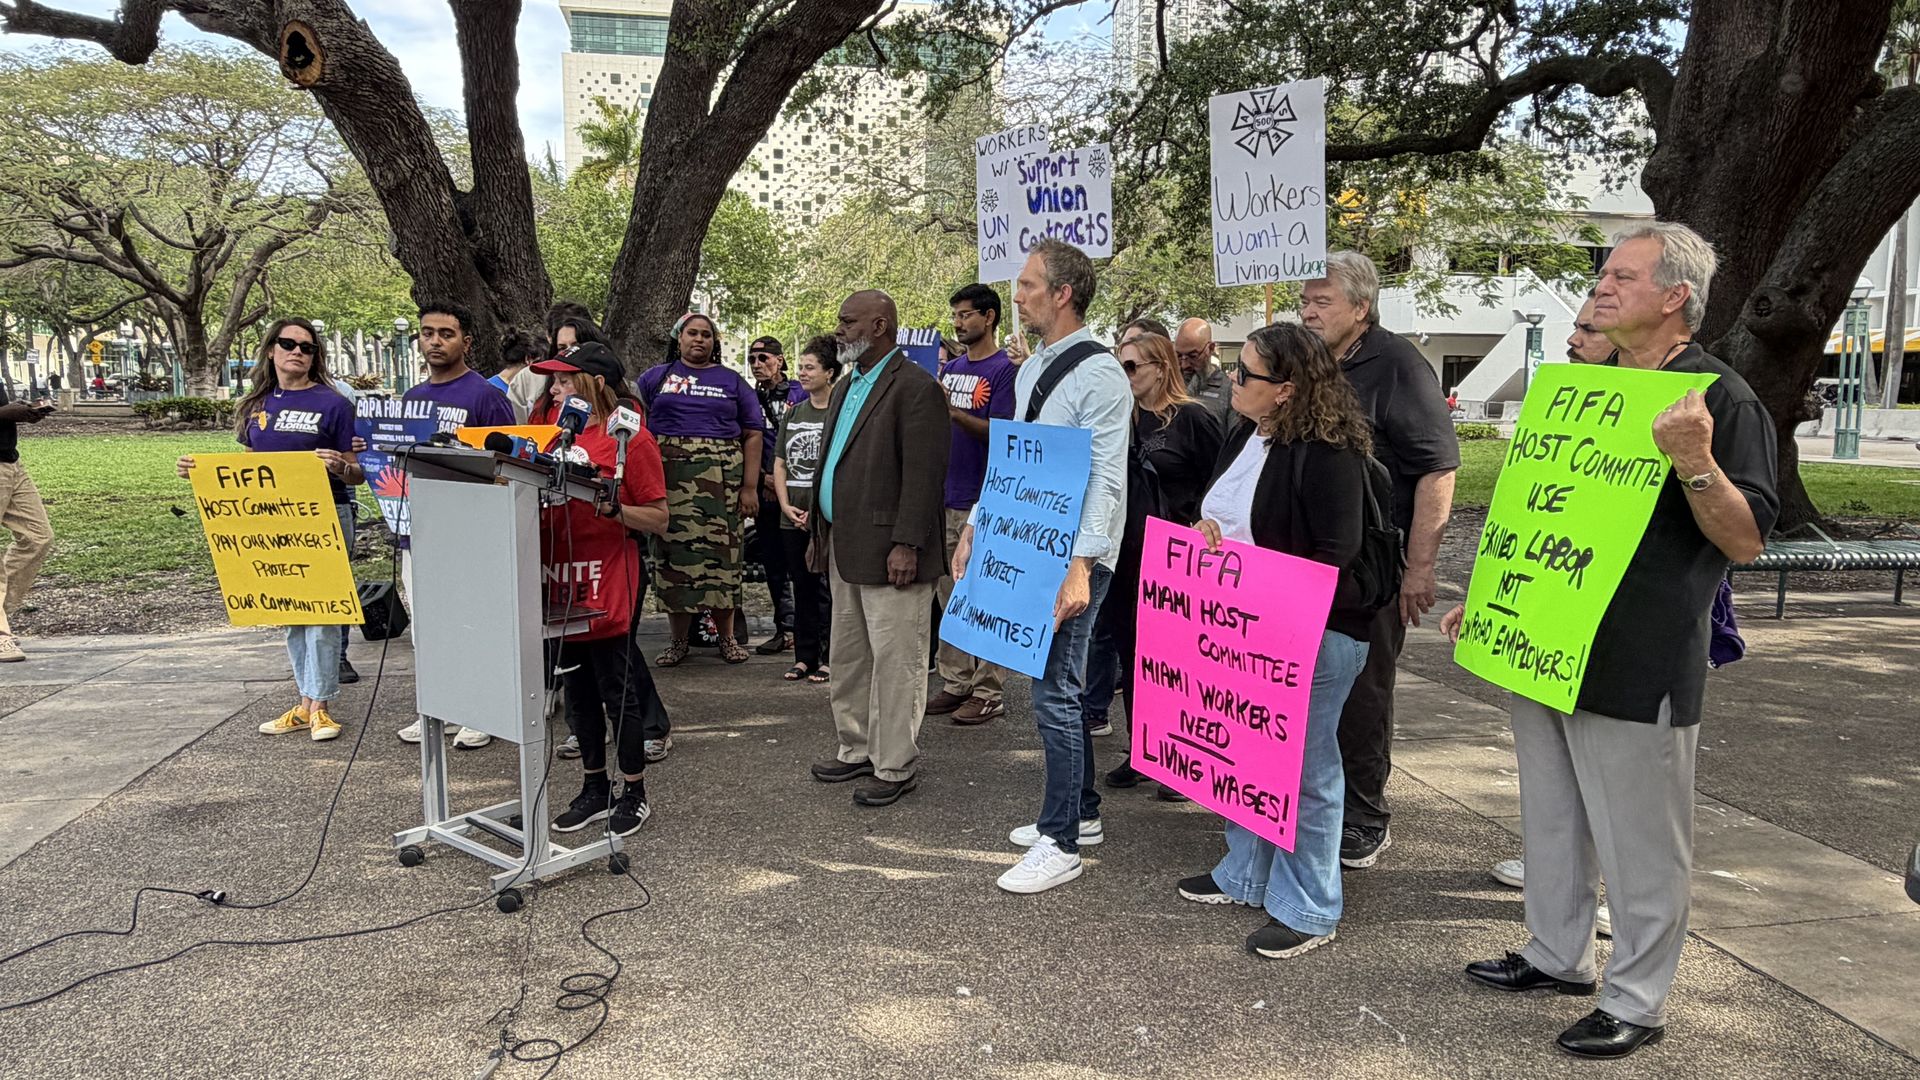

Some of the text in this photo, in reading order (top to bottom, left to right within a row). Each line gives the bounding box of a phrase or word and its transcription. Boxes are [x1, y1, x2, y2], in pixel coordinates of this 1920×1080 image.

[977, 125, 1046, 156] WORKERS
[1018, 151, 1080, 185] Support
[1215, 172, 1321, 222] Workers
[1217, 225, 1283, 255] Want
[1216, 253, 1326, 286] Living Wage
[896, 328, 936, 346] OR ALL!
[941, 373, 979, 392] BEYOND
[276, 409, 322, 424] SEIU
[356, 399, 433, 419] COPA FOR ALL!
[437, 407, 468, 424] YOND
[950, 391, 973, 409] BARS
[1545, 385, 1625, 428] FIFA
[273, 421, 319, 431] FLORIDA
[1007, 434, 1043, 464] FIFA
[1508, 426, 1572, 467] HOST
[216, 465, 277, 489] FIFA
[984, 466, 1072, 515] HOST COMMITTEE
[199, 495, 320, 521] HOST COMMITTEE
[1526, 482, 1575, 513] USE
[211, 522, 341, 557] PAY OUR WORKERS!
[976, 506, 1076, 570] PAY OUR WORKERS!
[253, 560, 310, 578] PROTECT
[541, 560, 603, 584] NITE
[978, 549, 1025, 591] PROTECT
[1166, 536, 1242, 589] FIFA
[1481, 521, 1594, 591] SKILLED LABOR
[1495, 569, 1535, 605] NOT
[228, 590, 358, 622] OUR COMMUNITIES!
[947, 595, 965, 616] OUR
[1142, 579, 1260, 639] MIAMI HOST
[1198, 633, 1300, 688] COMMITTEE
[1491, 625, 1587, 697] EMPLOYERS!
[1141, 655, 1289, 743] MIAMI WORKERS
[1180, 709, 1231, 749] NEED
[1142, 723, 1290, 836] LIVING WAGES!
